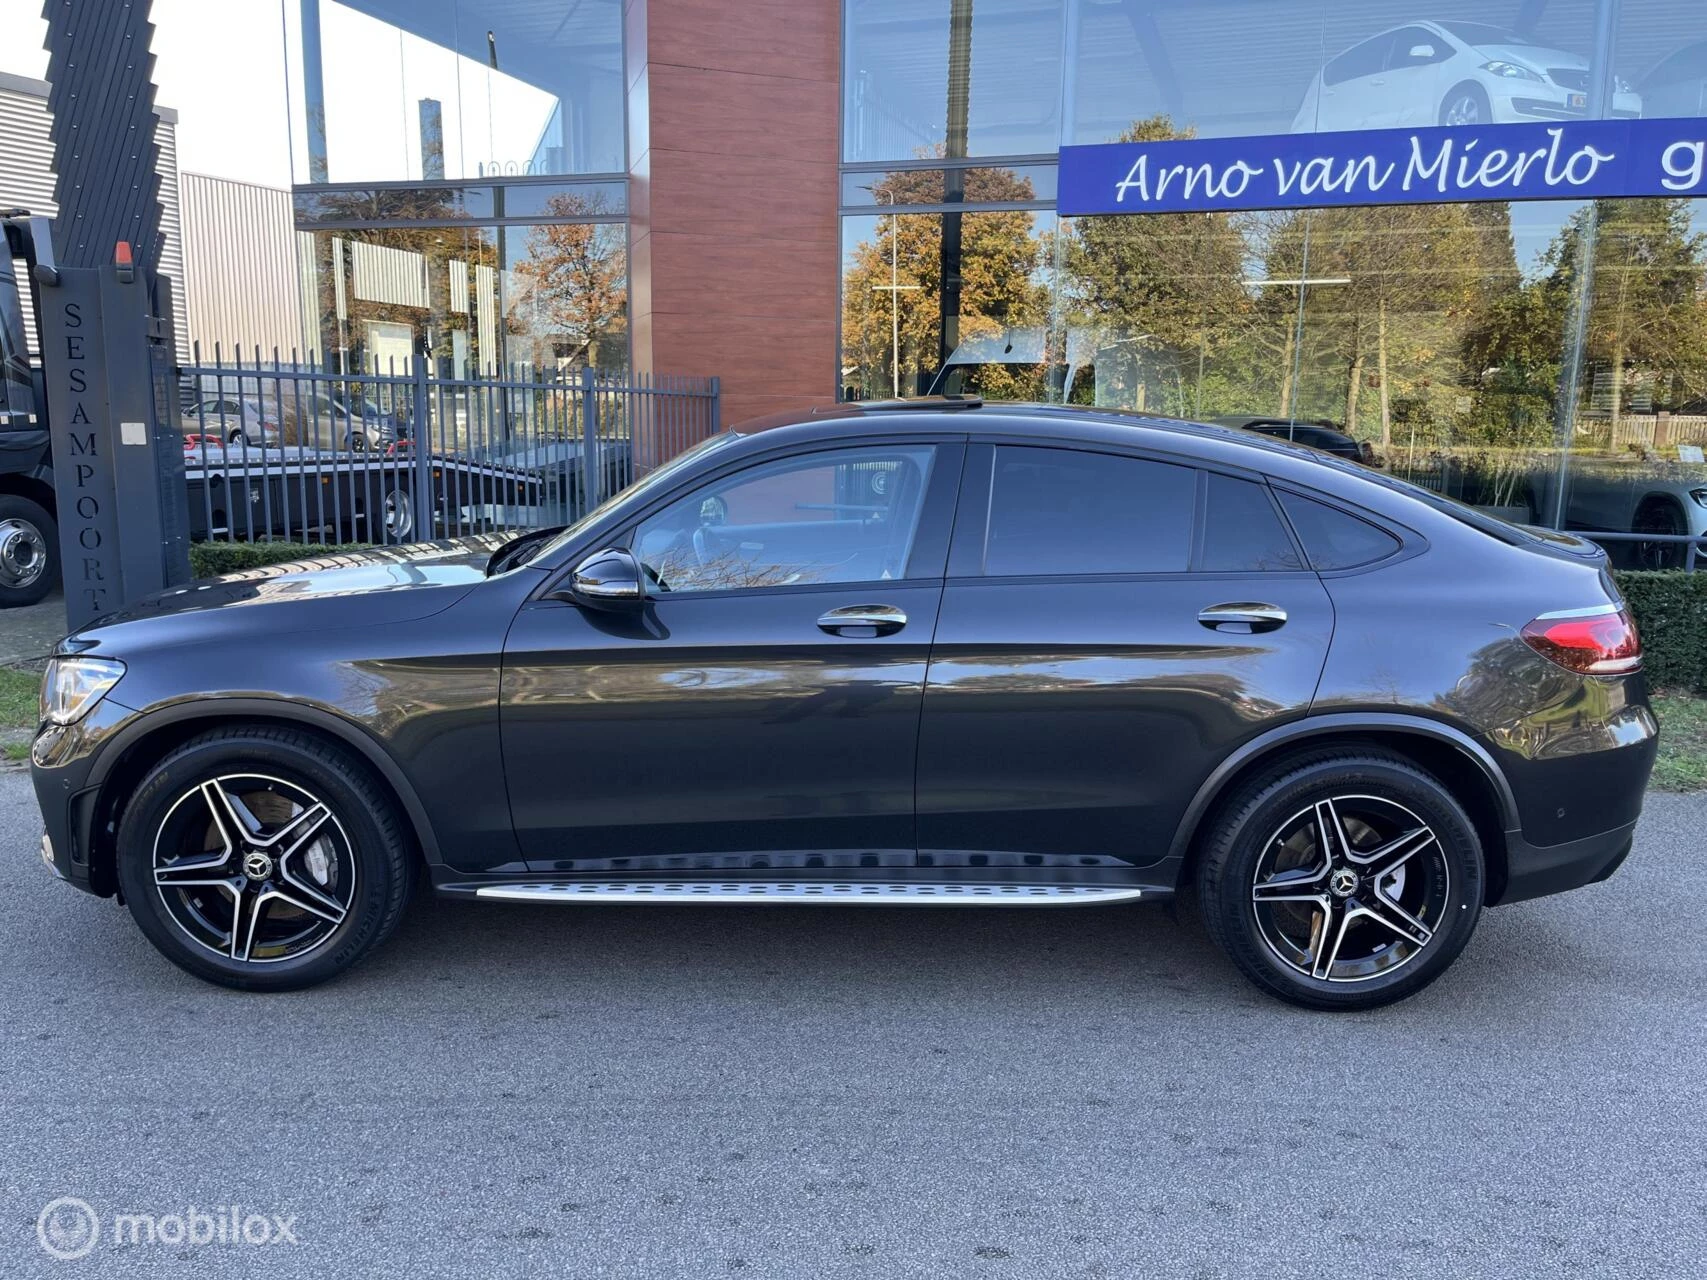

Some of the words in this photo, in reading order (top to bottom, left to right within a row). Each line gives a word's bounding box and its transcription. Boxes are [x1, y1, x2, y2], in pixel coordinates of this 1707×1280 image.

[1116, 155, 1264, 202] Arno
[1274, 155, 1395, 196] van
[1402, 128, 1615, 193] Mierlo
[64, 303, 106, 611] SESAMPOORT
